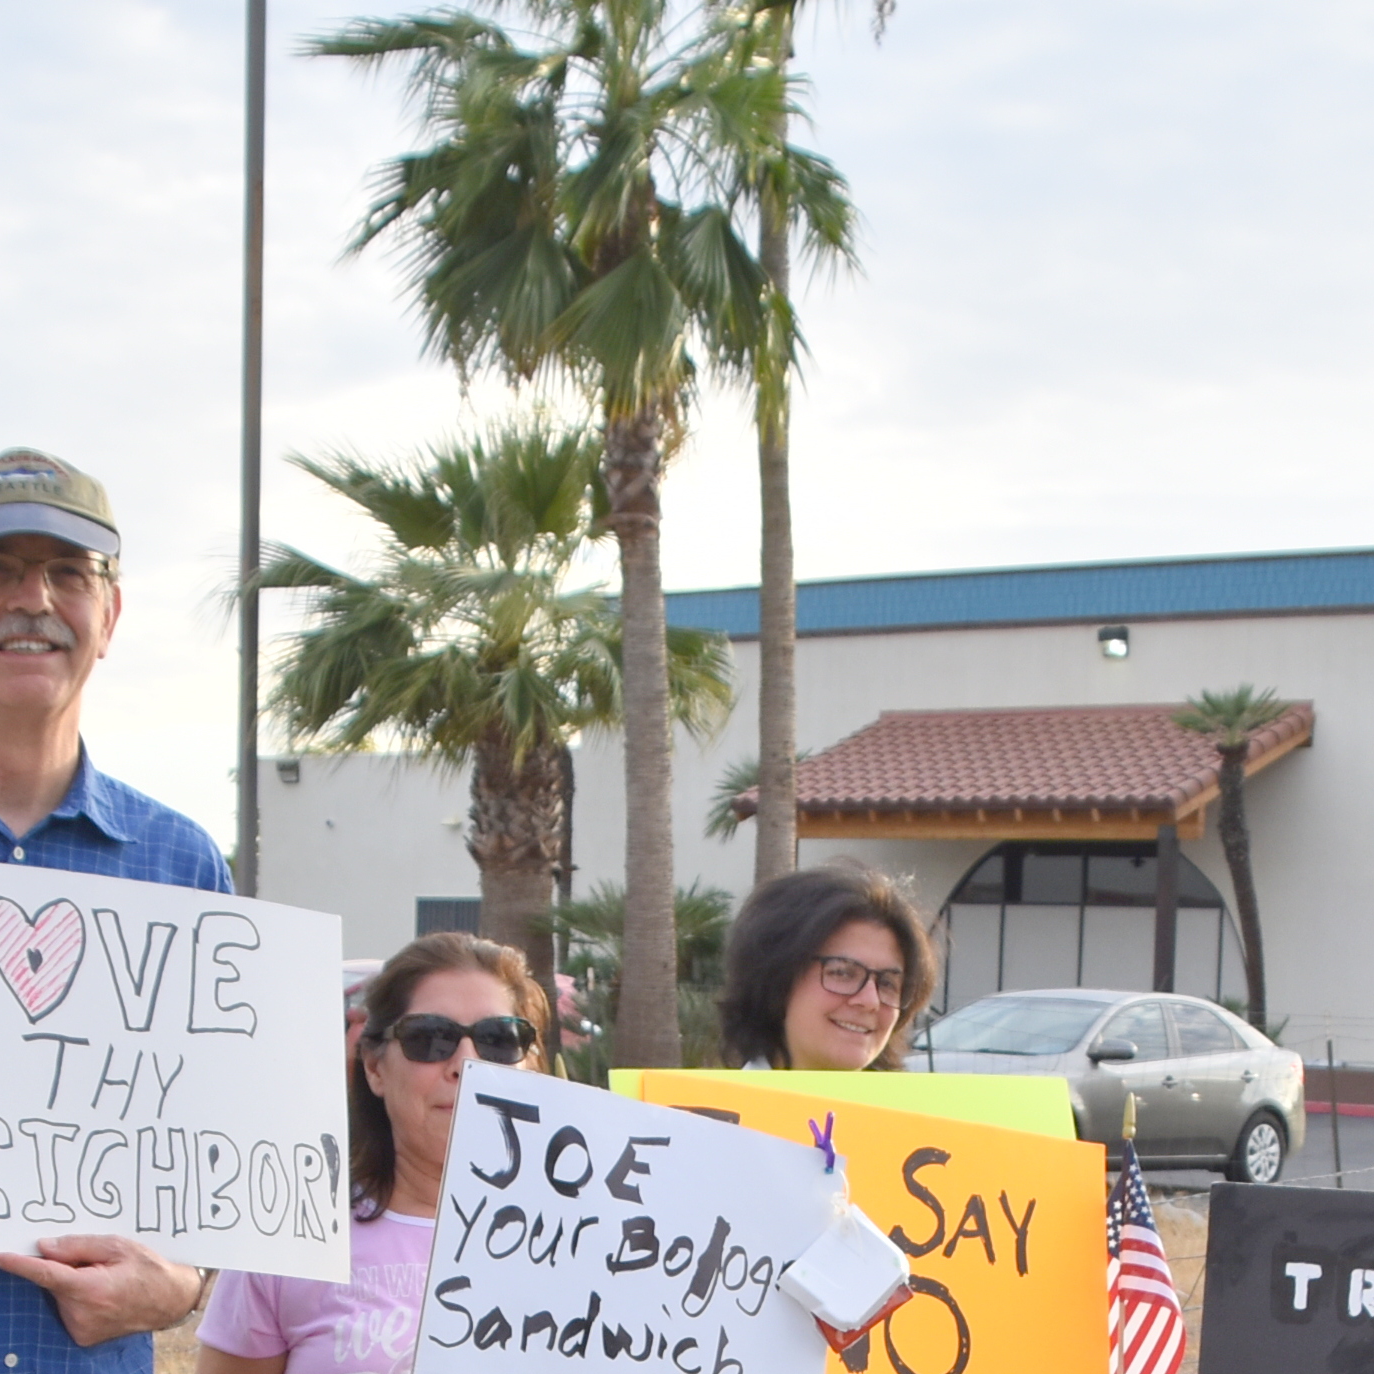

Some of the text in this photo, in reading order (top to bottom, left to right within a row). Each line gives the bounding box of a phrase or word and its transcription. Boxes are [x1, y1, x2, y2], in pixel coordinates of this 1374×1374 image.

[22, 1032, 184, 1120] THY
[470, 1093, 671, 1204] JOE
[890, 1147, 1037, 1277] SAY
[333, 1306, 415, 1363] we
